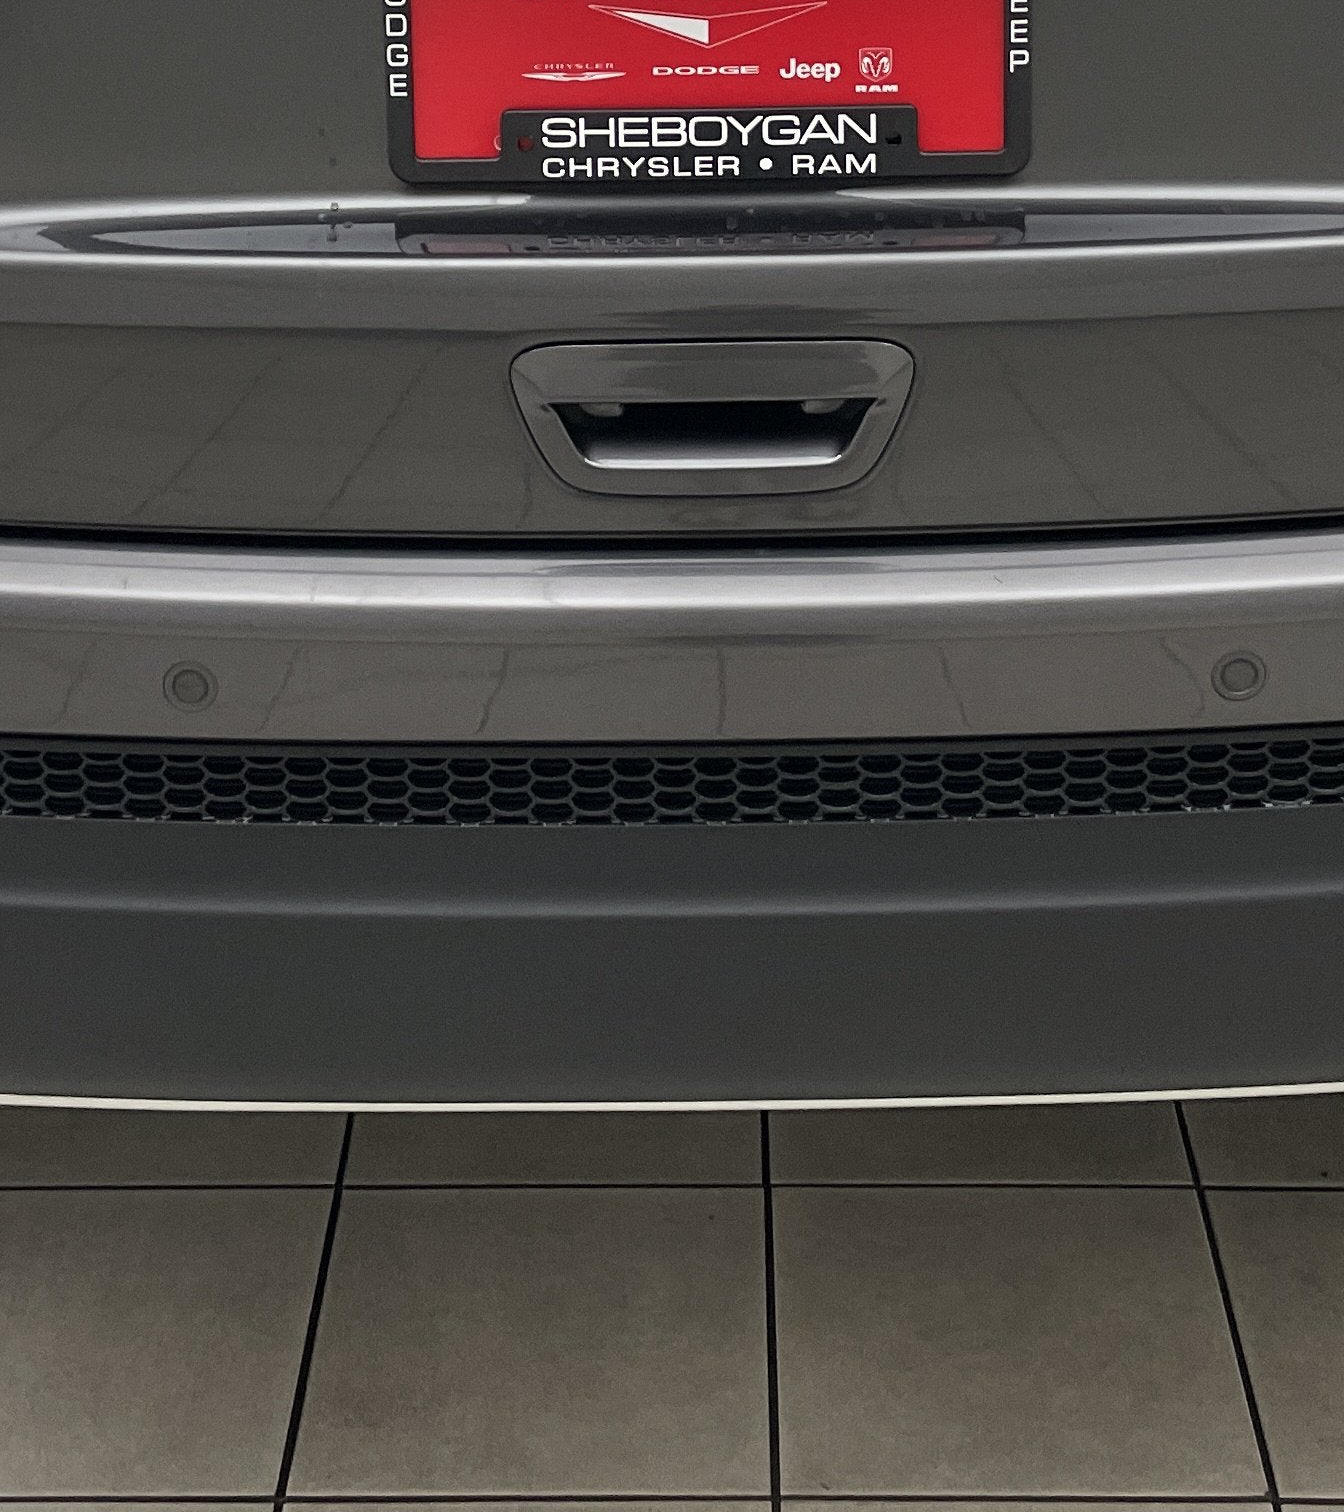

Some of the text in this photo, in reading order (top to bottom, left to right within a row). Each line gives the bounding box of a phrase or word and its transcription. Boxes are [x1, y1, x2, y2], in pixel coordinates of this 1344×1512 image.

[533, 62, 615, 70] CHRYSLER
[652, 65, 760, 76] DODGE
[779, 58, 841, 82] Jeep
[854, 84, 899, 94] RAM
[541, 113, 877, 149] SHEBOYGAN
[542, 153, 877, 178] CHRYSLER RAM
